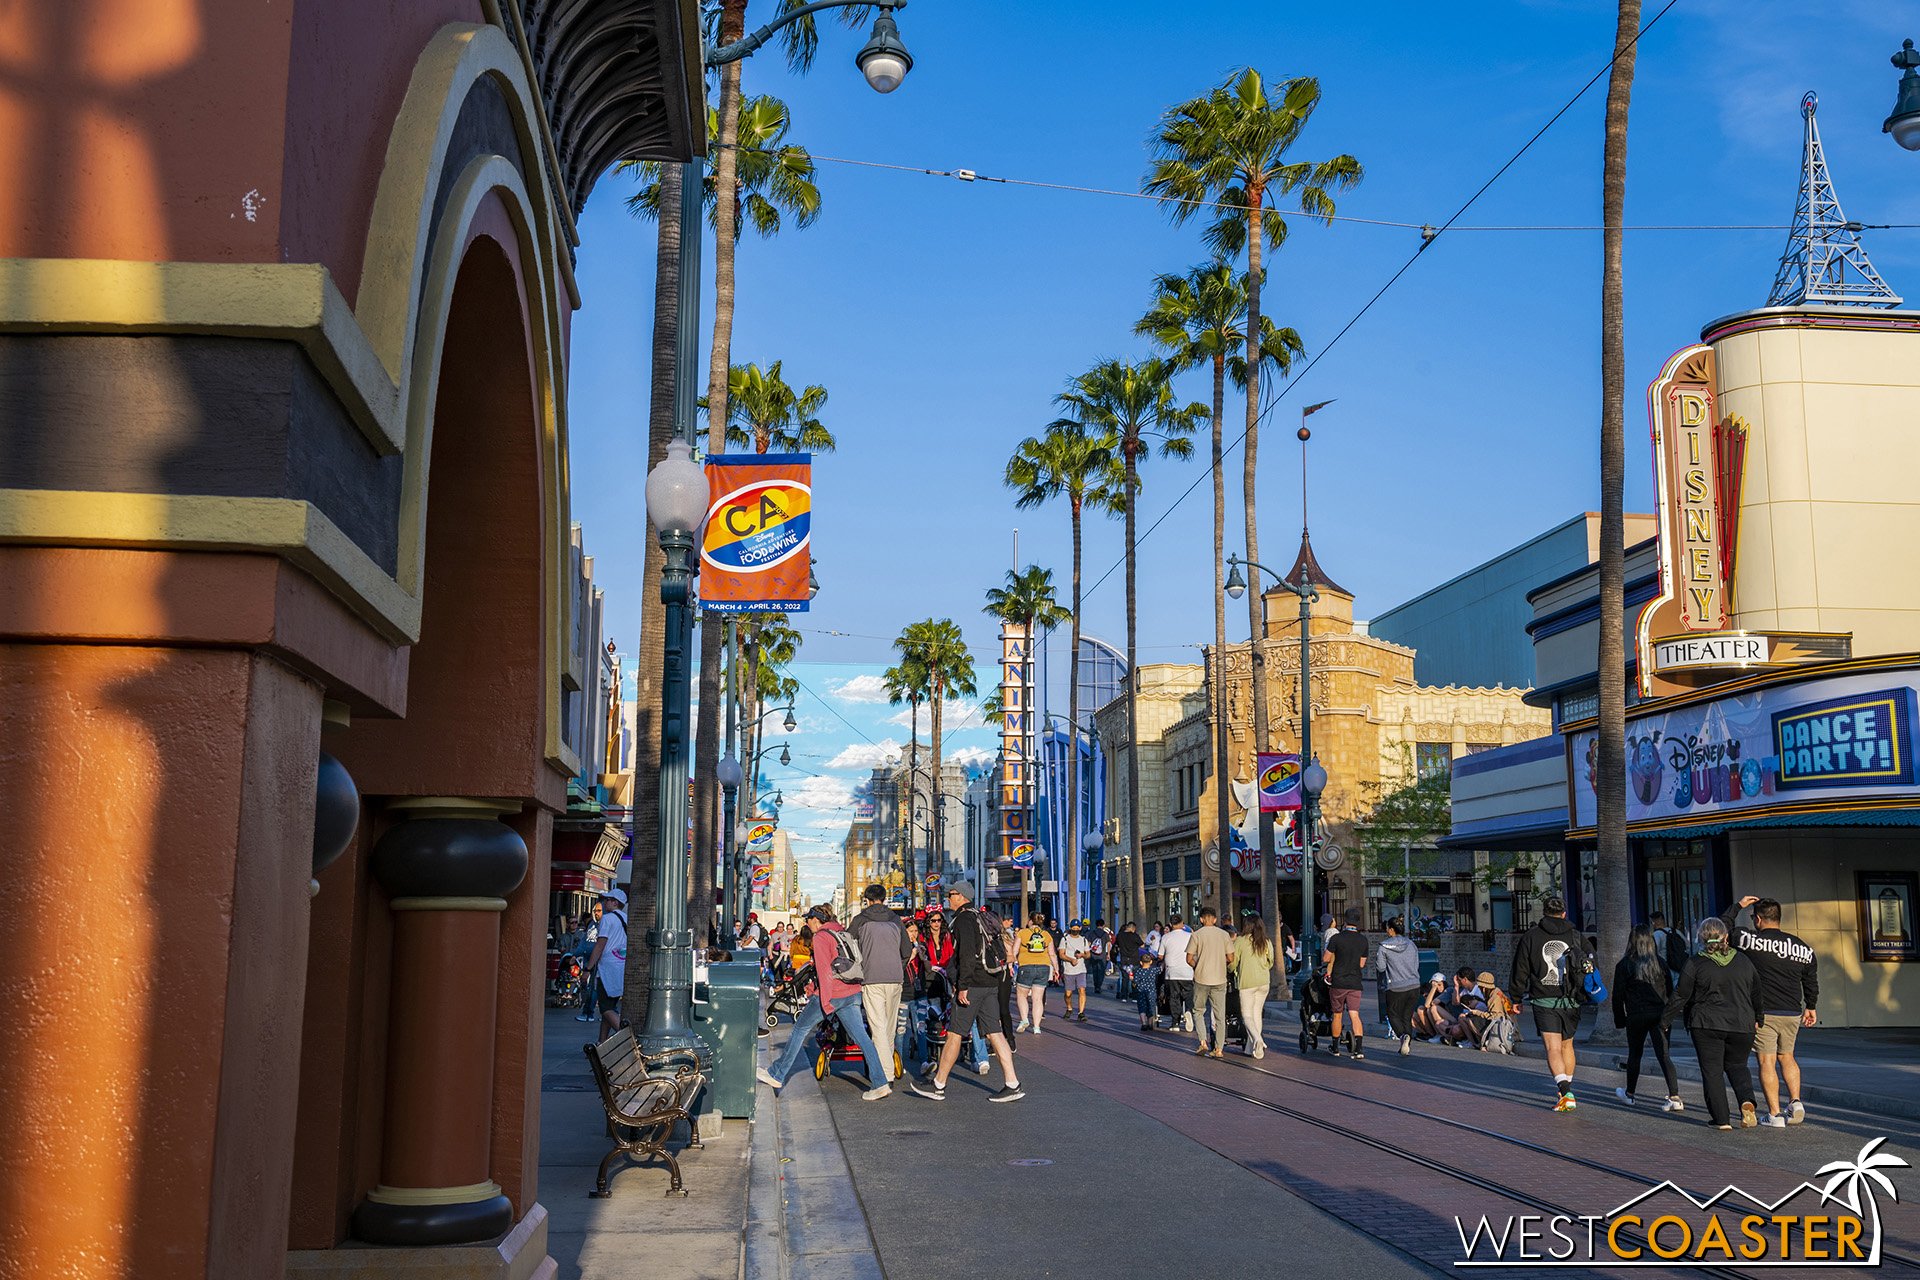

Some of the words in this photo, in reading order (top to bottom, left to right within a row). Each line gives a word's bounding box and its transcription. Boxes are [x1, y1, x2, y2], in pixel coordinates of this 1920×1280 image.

[725, 494, 778, 537] CA
[1679, 393, 1715, 621] DISNEY
[761, 550, 784, 563] FESTIVAL
[1661, 640, 1761, 664] THEATER
[1782, 710, 1877, 749] DANCE
[1784, 739, 1891, 775] PARTY!
[1268, 765, 1292, 783] CA
[753, 827, 769, 838] CA
[1274, 854, 1304, 874] age
[1737, 930, 1814, 963] Disneyland
